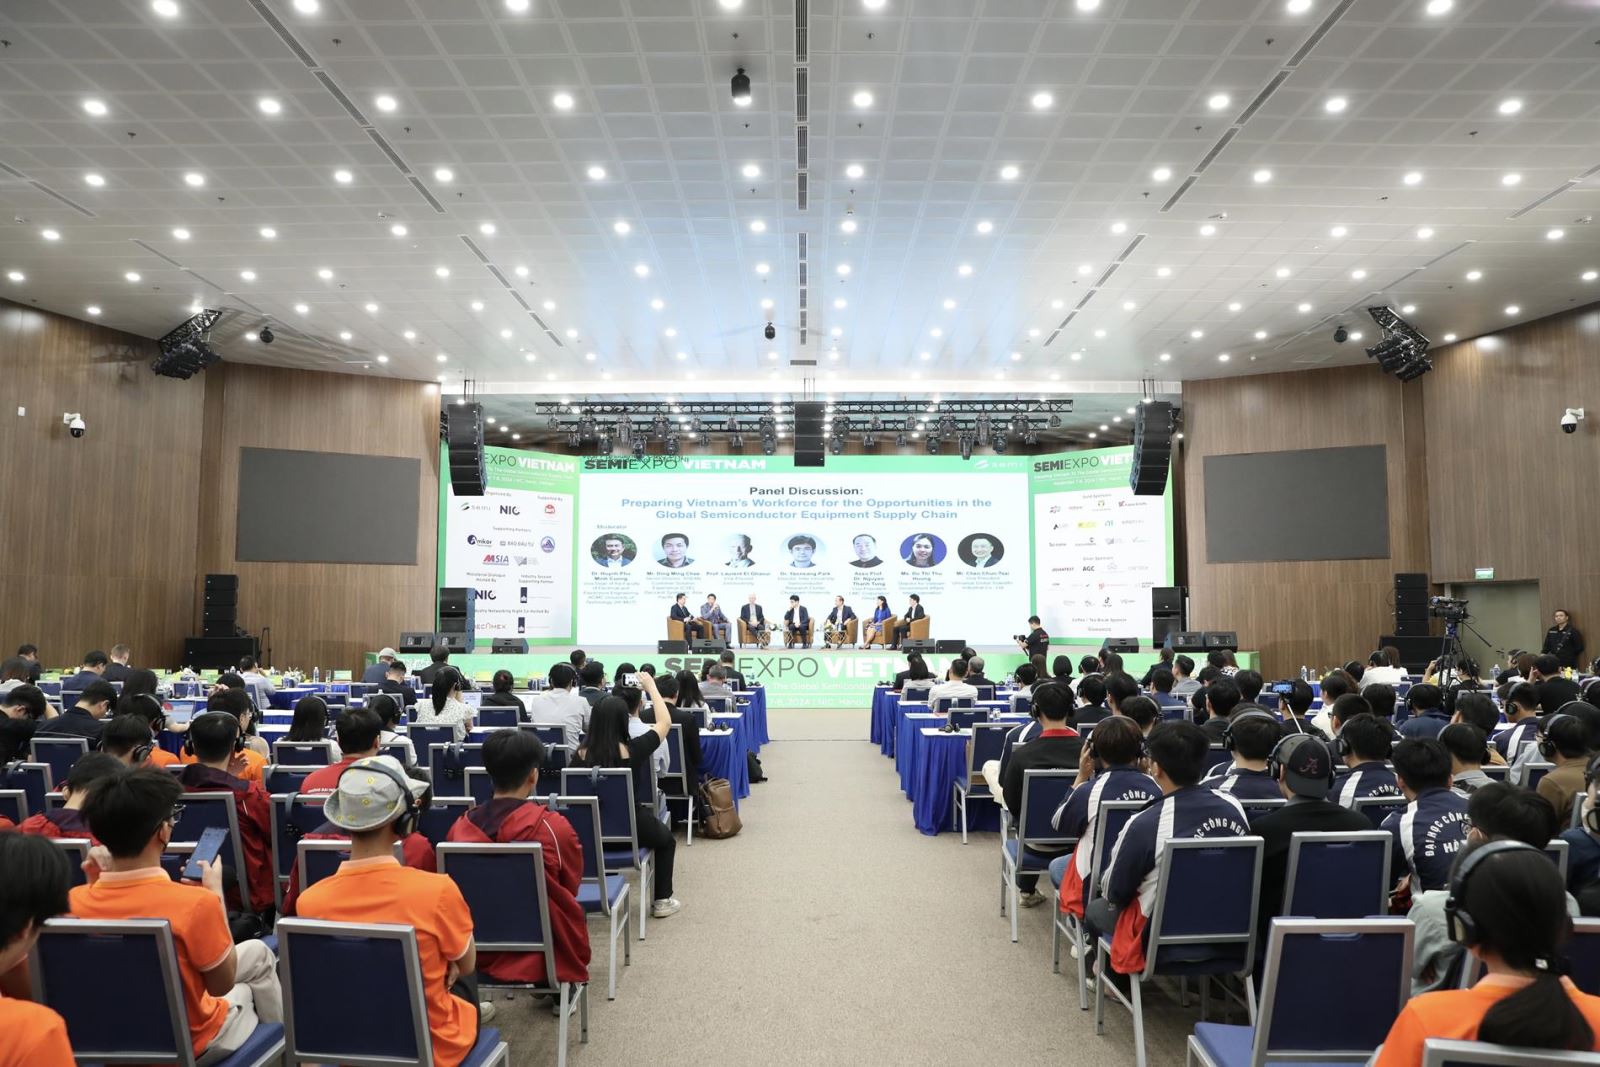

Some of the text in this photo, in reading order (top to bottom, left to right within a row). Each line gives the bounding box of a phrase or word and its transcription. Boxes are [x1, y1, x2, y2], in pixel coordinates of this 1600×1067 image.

[518, 457, 575, 472] VIETNAM
[584, 459, 767, 470] SEMIEXPO VIETNAM
[1033, 456, 1099, 472] SEMIEXPO
[749, 486, 864, 495] Panel Discussion:
[621, 498, 992, 509] Preparing Vietnam's Workforce for the Opportunities in the
[499, 504, 520, 516] NIC
[656, 510, 958, 521] Global Semiconductor Equipment Supply Chain
[483, 554, 510, 563] MSIA
[475, 589, 497, 601] NIC
